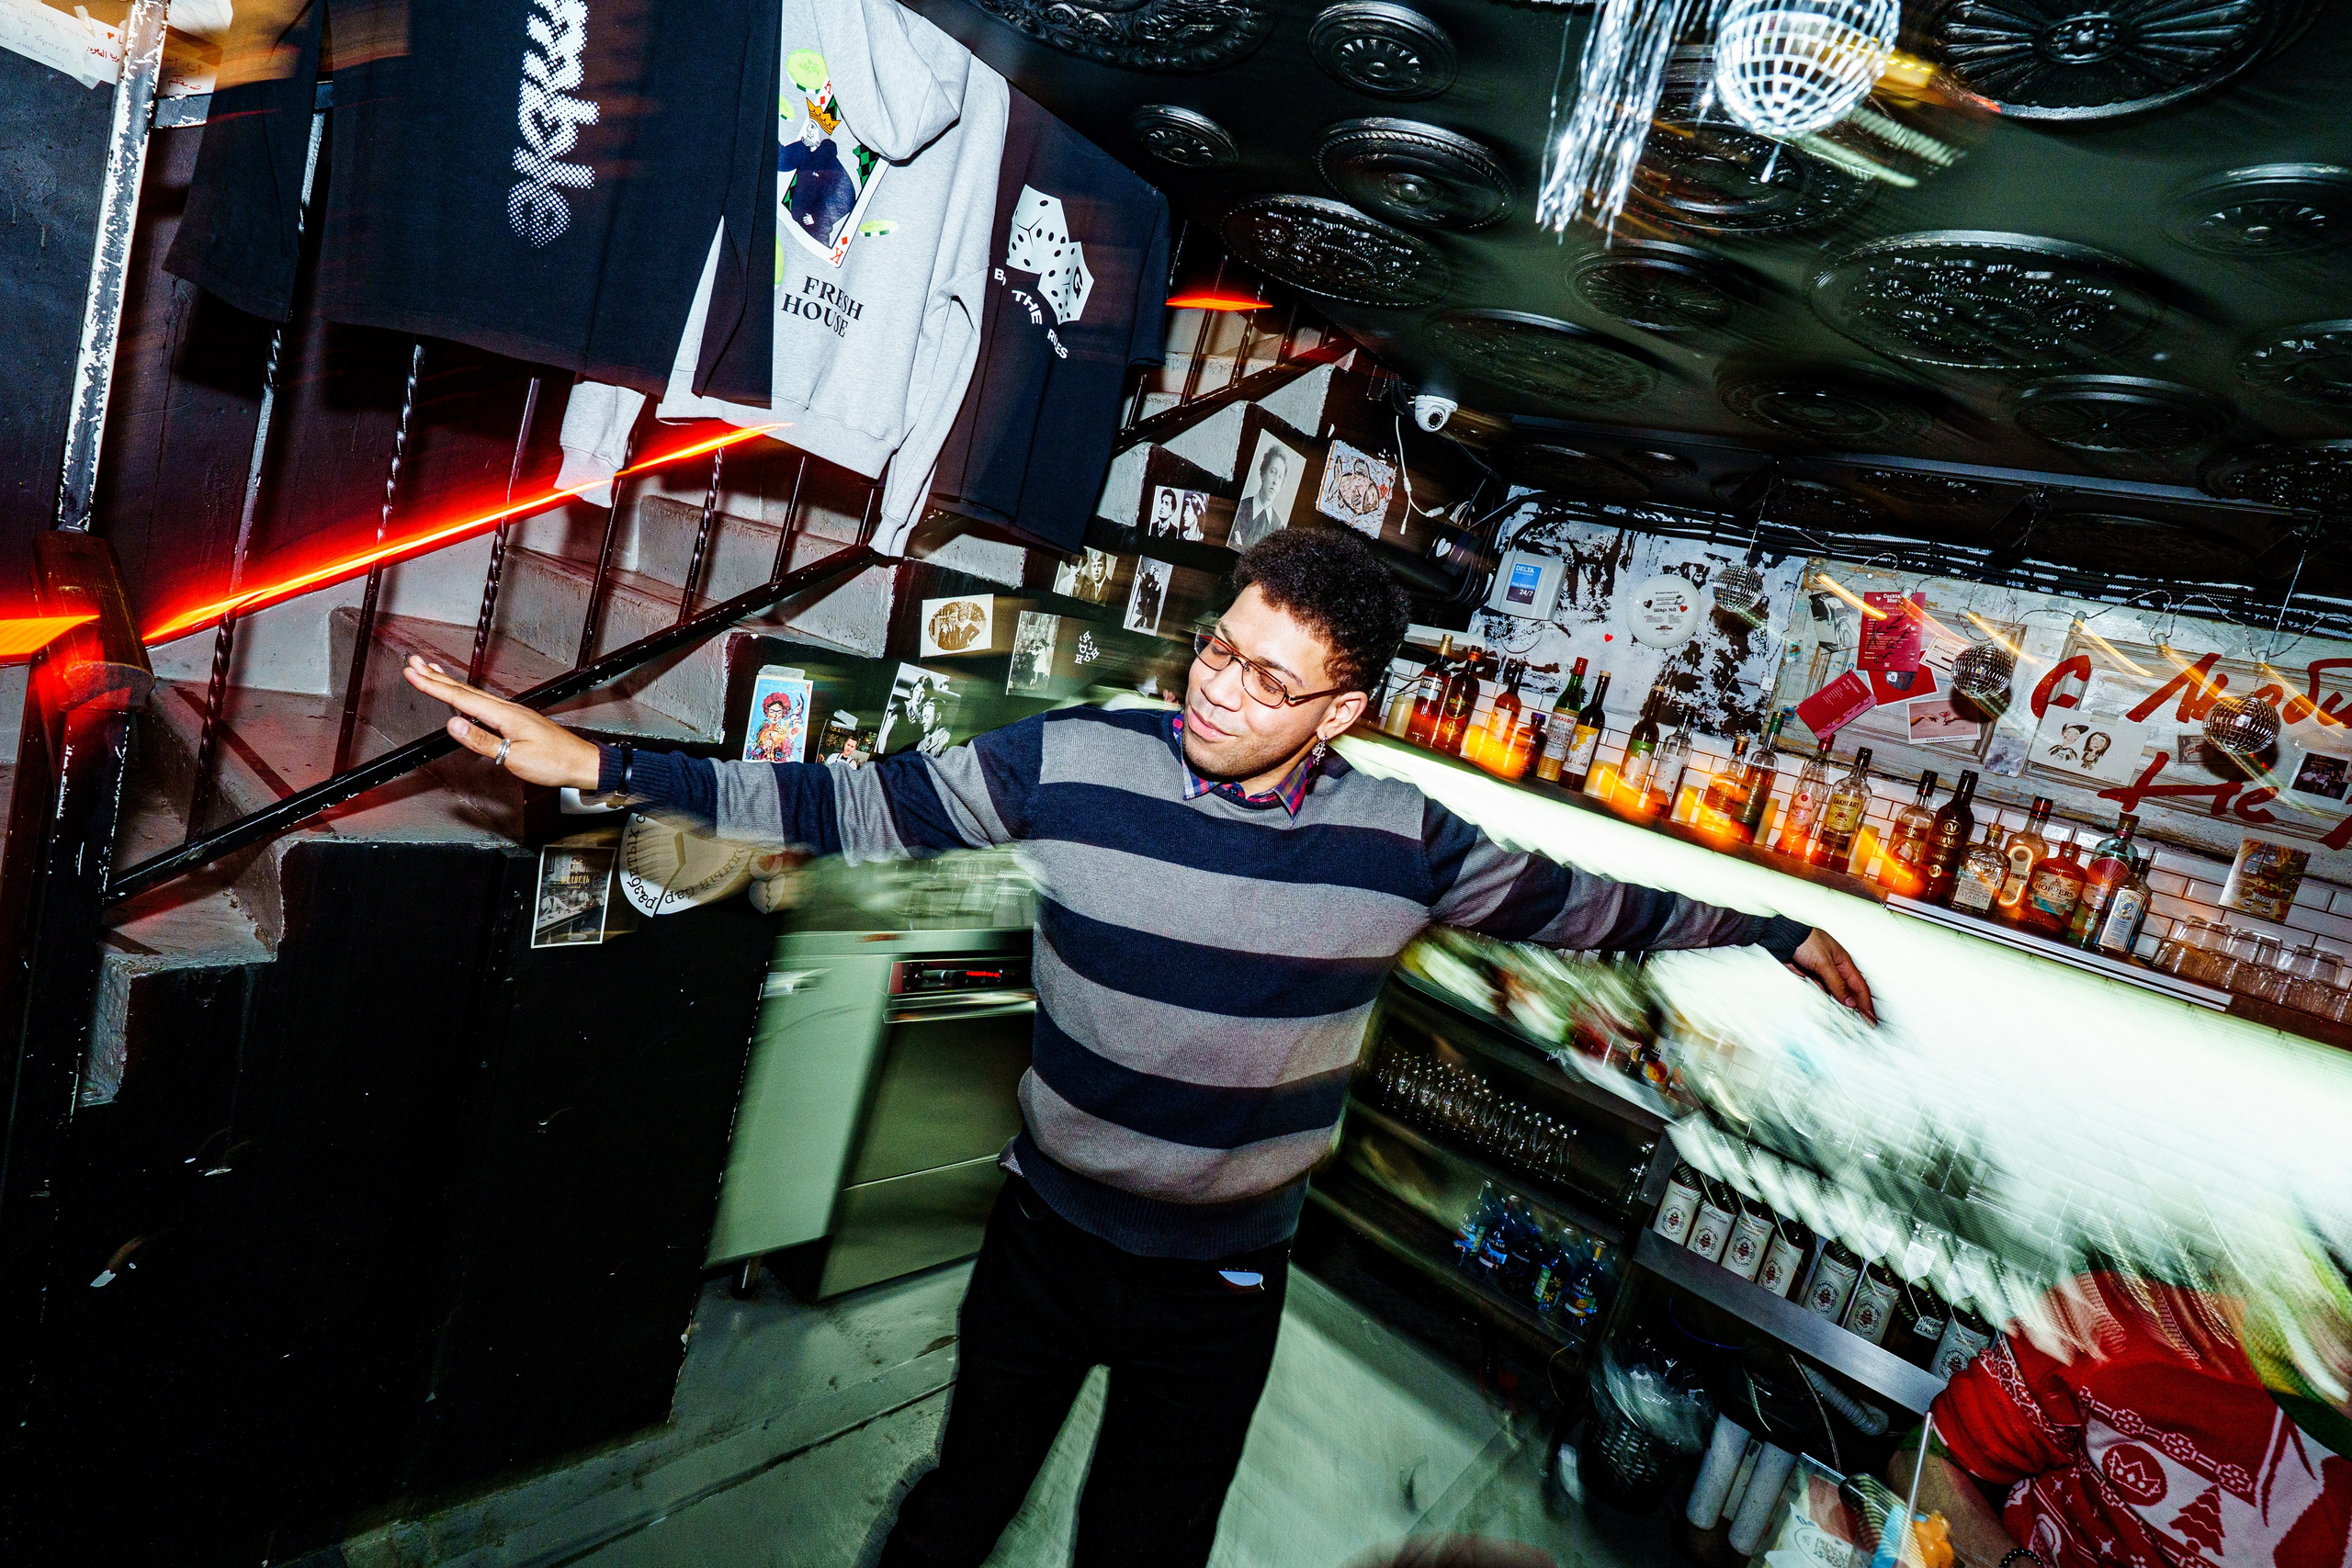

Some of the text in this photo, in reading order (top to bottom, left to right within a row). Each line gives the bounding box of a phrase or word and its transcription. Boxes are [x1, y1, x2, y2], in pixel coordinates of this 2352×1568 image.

[802, 276, 865, 321] FRESH
[1012, 289, 1043, 325] THE
[781, 293, 849, 338] HOUSE
[1515, 565, 1534, 574] DELTA
[1519, 588, 1534, 597] 24/7
[1832, 796, 1860, 809] OAKHEART
[627, 828, 659, 910] разбитых
[664, 887, 695, 905] бар
[2034, 882, 2074, 898] HOPPERS
